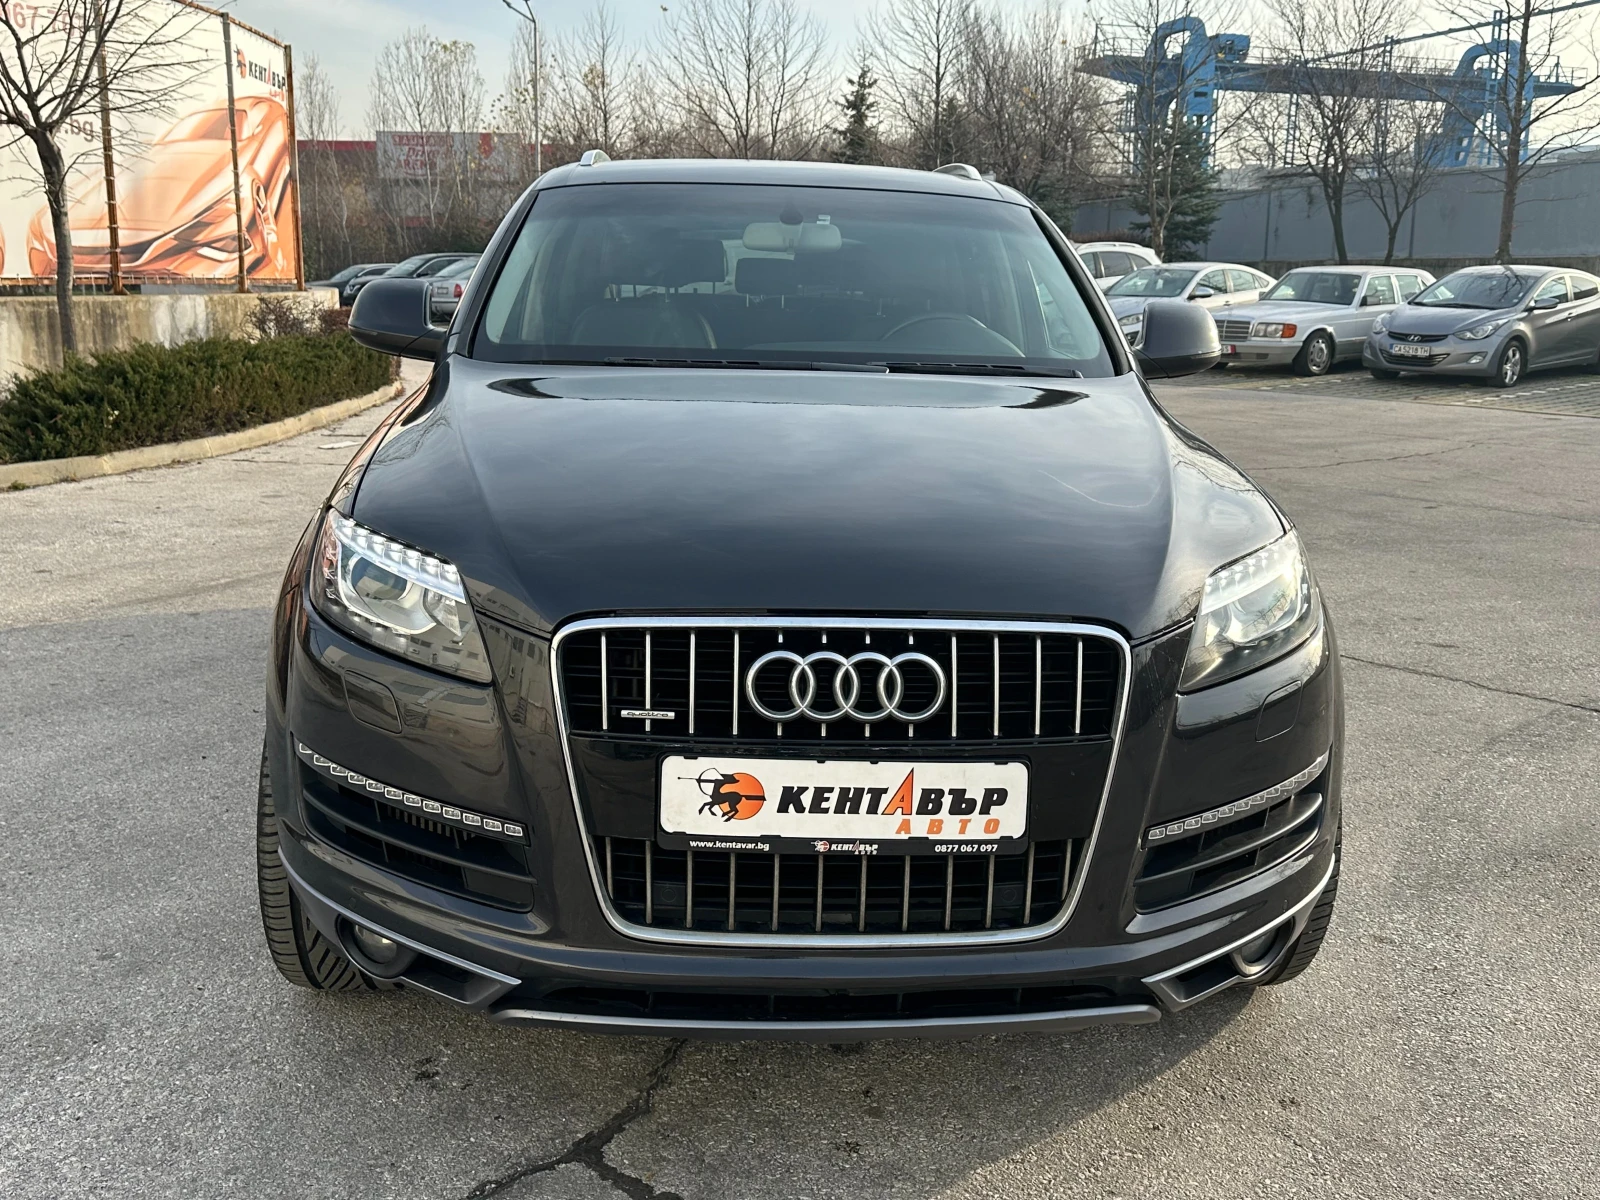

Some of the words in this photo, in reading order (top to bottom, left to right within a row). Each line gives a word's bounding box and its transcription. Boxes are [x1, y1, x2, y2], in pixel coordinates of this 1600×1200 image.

[776, 767, 1009, 816] КЕНТАВЪР
[895, 818, 1001, 835] АВТО
[689, 840, 770, 852] www.kentavar.bg
[831, 840, 879, 851] КЕНТАВЪР
[934, 844, 959, 853] 0877
[960, 844, 979, 853] 067
[980, 844, 998, 853] 097
